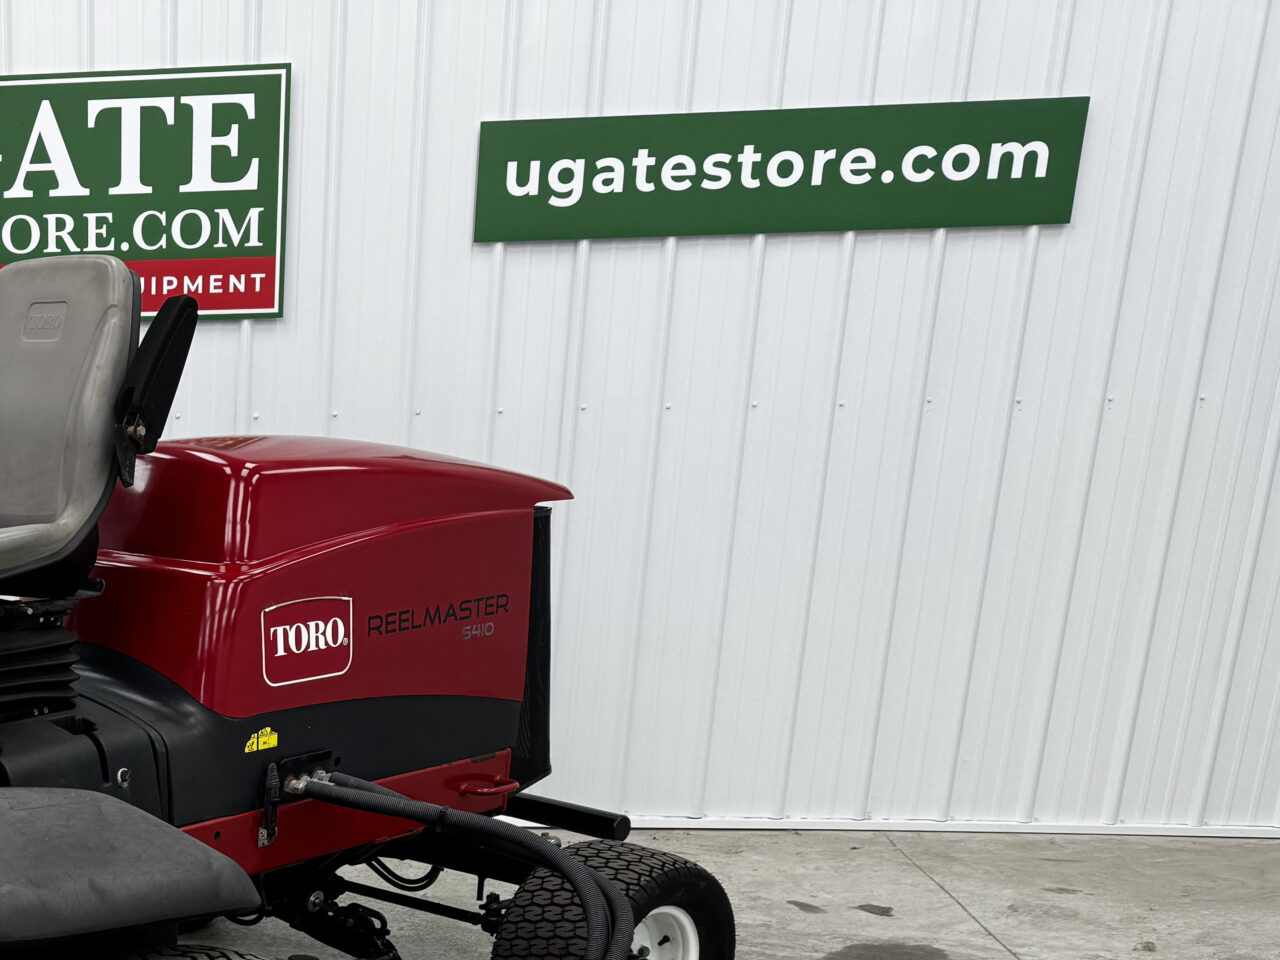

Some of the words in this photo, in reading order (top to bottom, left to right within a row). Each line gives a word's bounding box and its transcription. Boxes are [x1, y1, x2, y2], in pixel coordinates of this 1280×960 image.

[505, 139, 1051, 208] ugatestore.com
[140, 273, 266, 296] IPMENT
[367, 593, 510, 638] REELMASTER
[462, 621, 495, 641] 5410
[270, 617, 345, 657] TORO
